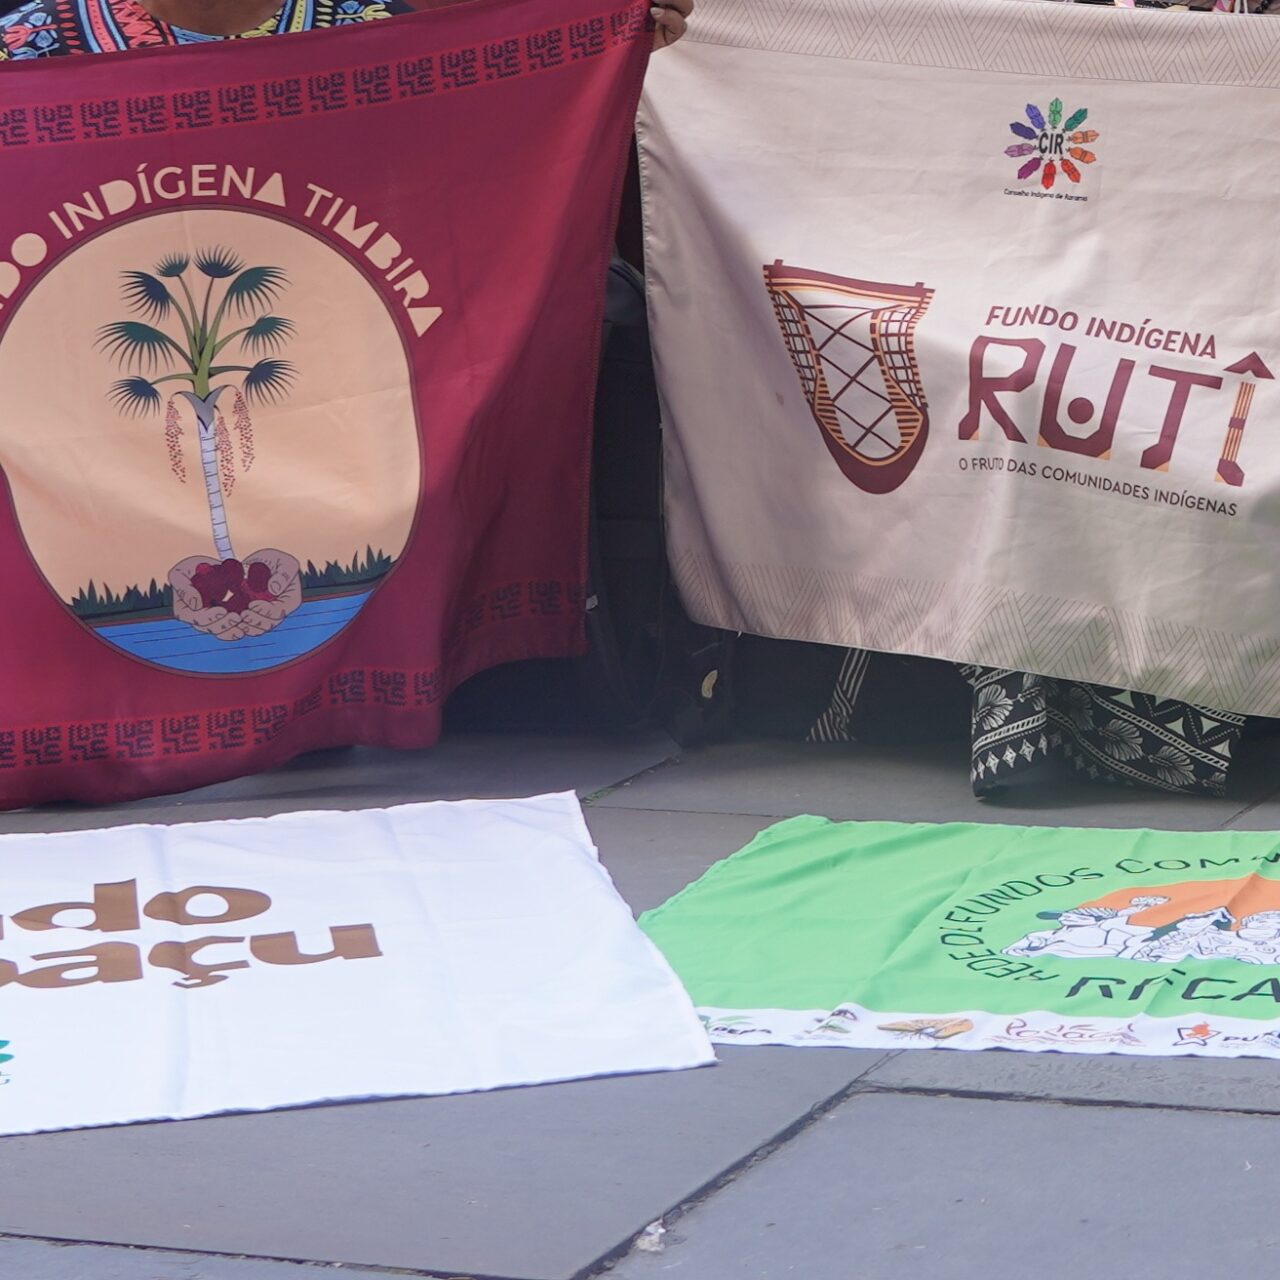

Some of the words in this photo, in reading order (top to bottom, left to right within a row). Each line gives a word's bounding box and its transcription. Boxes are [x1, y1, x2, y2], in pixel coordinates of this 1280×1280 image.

[1038, 131, 1064, 156] CIR
[49, 163, 286, 239] INDÍGENA
[304, 183, 443, 338] TIMBIRA
[986, 303, 1078, 332] FUNDO
[1085, 315, 1217, 360] INDÍGENA
[959, 457, 968, 471] O
[972, 457, 1004, 473] FRUTO
[1007, 459, 1037, 477] DAS
[1041, 465, 1149, 500] COMUNIDADES
[1154, 489, 1238, 517] INDÍGENAS
[945, 867, 1104, 923] FUNDOS
